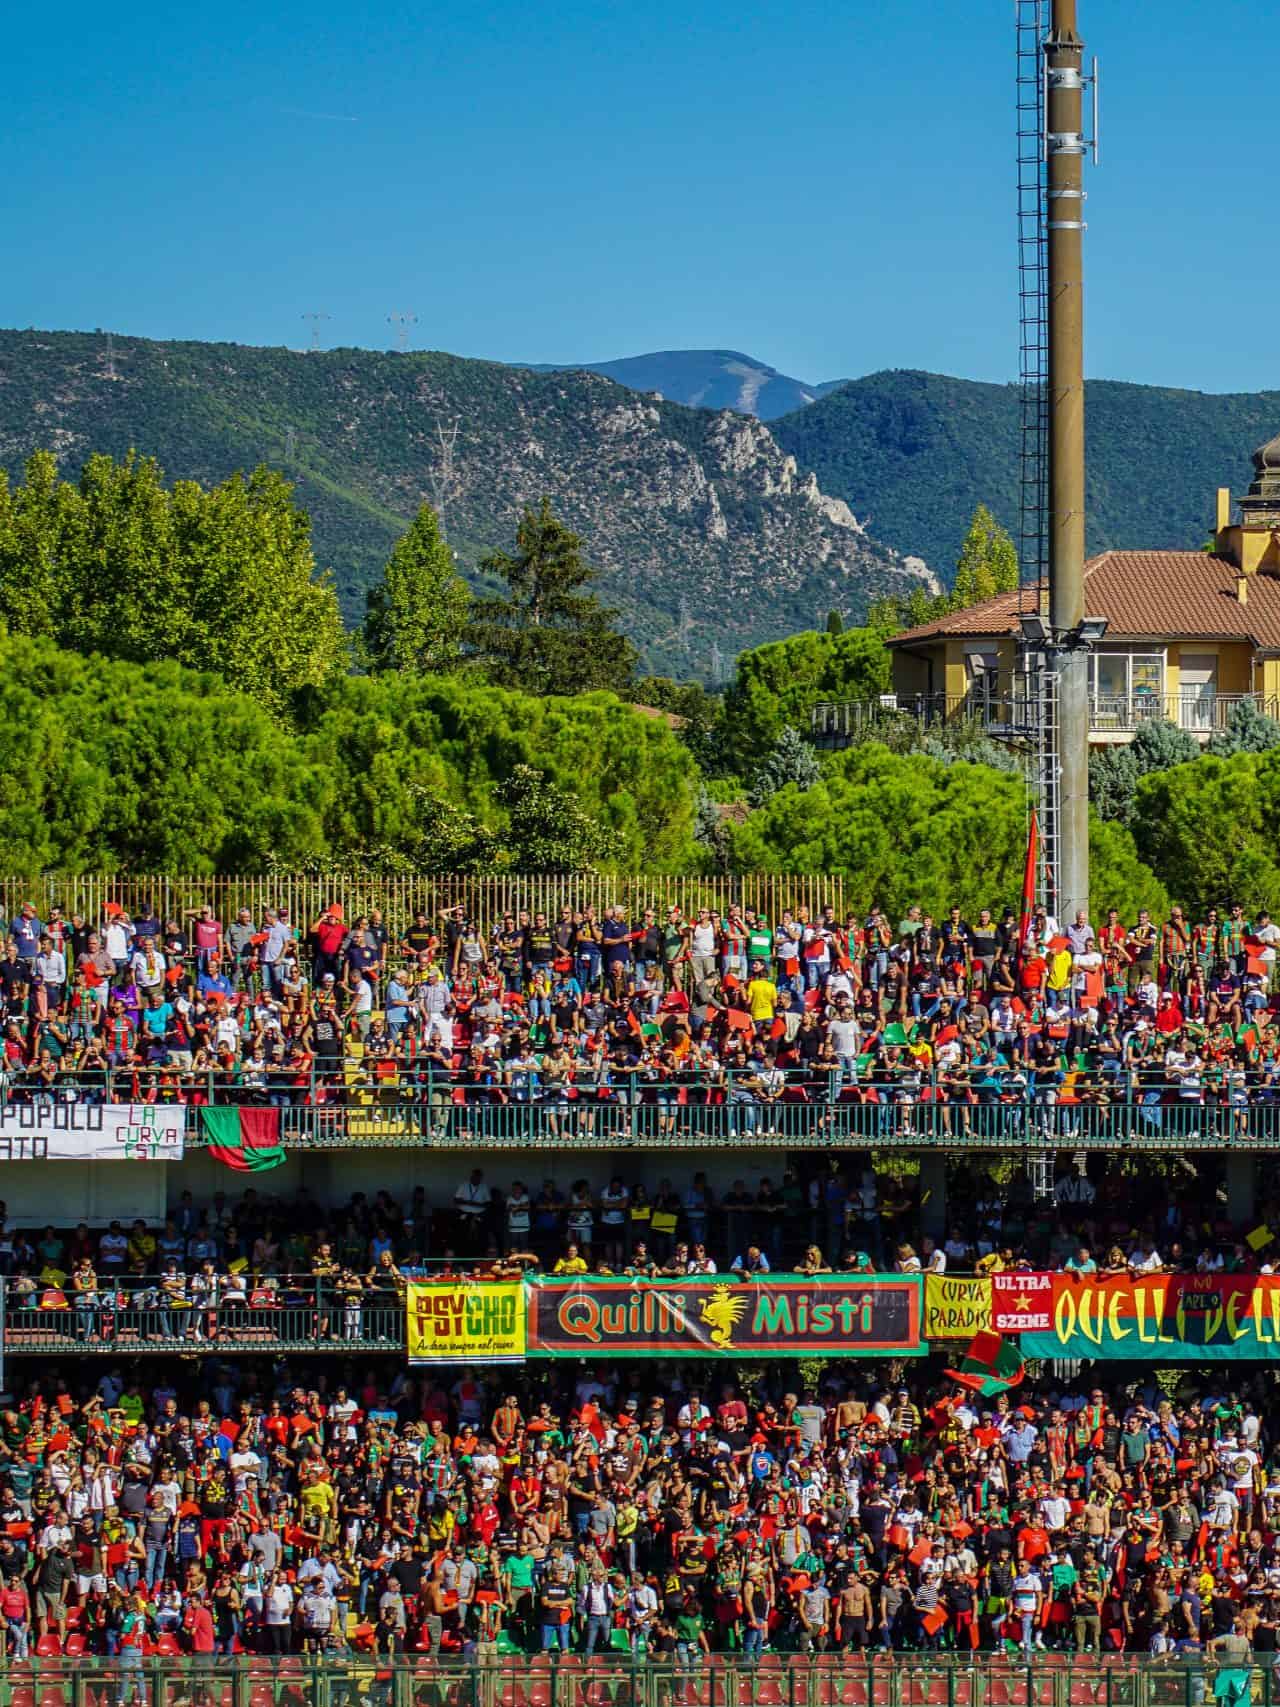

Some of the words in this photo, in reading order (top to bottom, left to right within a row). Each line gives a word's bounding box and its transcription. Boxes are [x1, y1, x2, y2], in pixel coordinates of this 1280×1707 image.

[1, 1104, 103, 1131] POPOLO
[129, 1104, 155, 1126] LA
[116, 1126, 177, 1143] CURVA
[125, 1143, 160, 1160] EST
[942, 1281, 985, 1302] CURVA
[995, 1276, 1051, 1291] ULTRA
[416, 1294, 516, 1336] PSYCHO
[558, 1291, 687, 1342] Quilli
[752, 1294, 874, 1335] Misti
[996, 1313, 1050, 1328] SZENE
